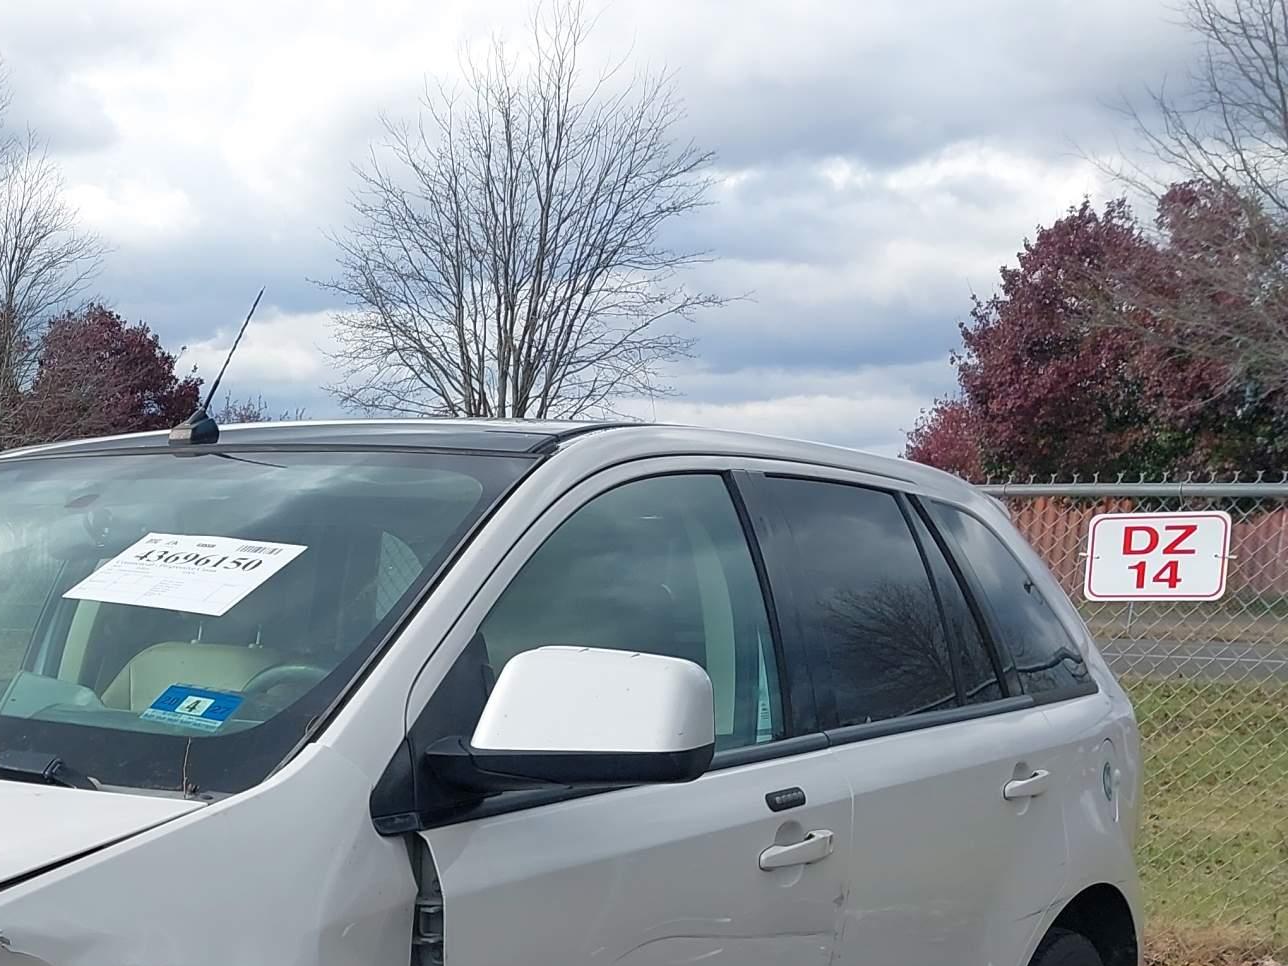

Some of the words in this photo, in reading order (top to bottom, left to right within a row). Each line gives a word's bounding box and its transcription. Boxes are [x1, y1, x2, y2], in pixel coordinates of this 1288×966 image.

[1122, 524, 1198, 556] DZ
[134, 549, 263, 572] 43696150
[1127, 560, 1182, 589] 14
[184, 699, 202, 713] 4
